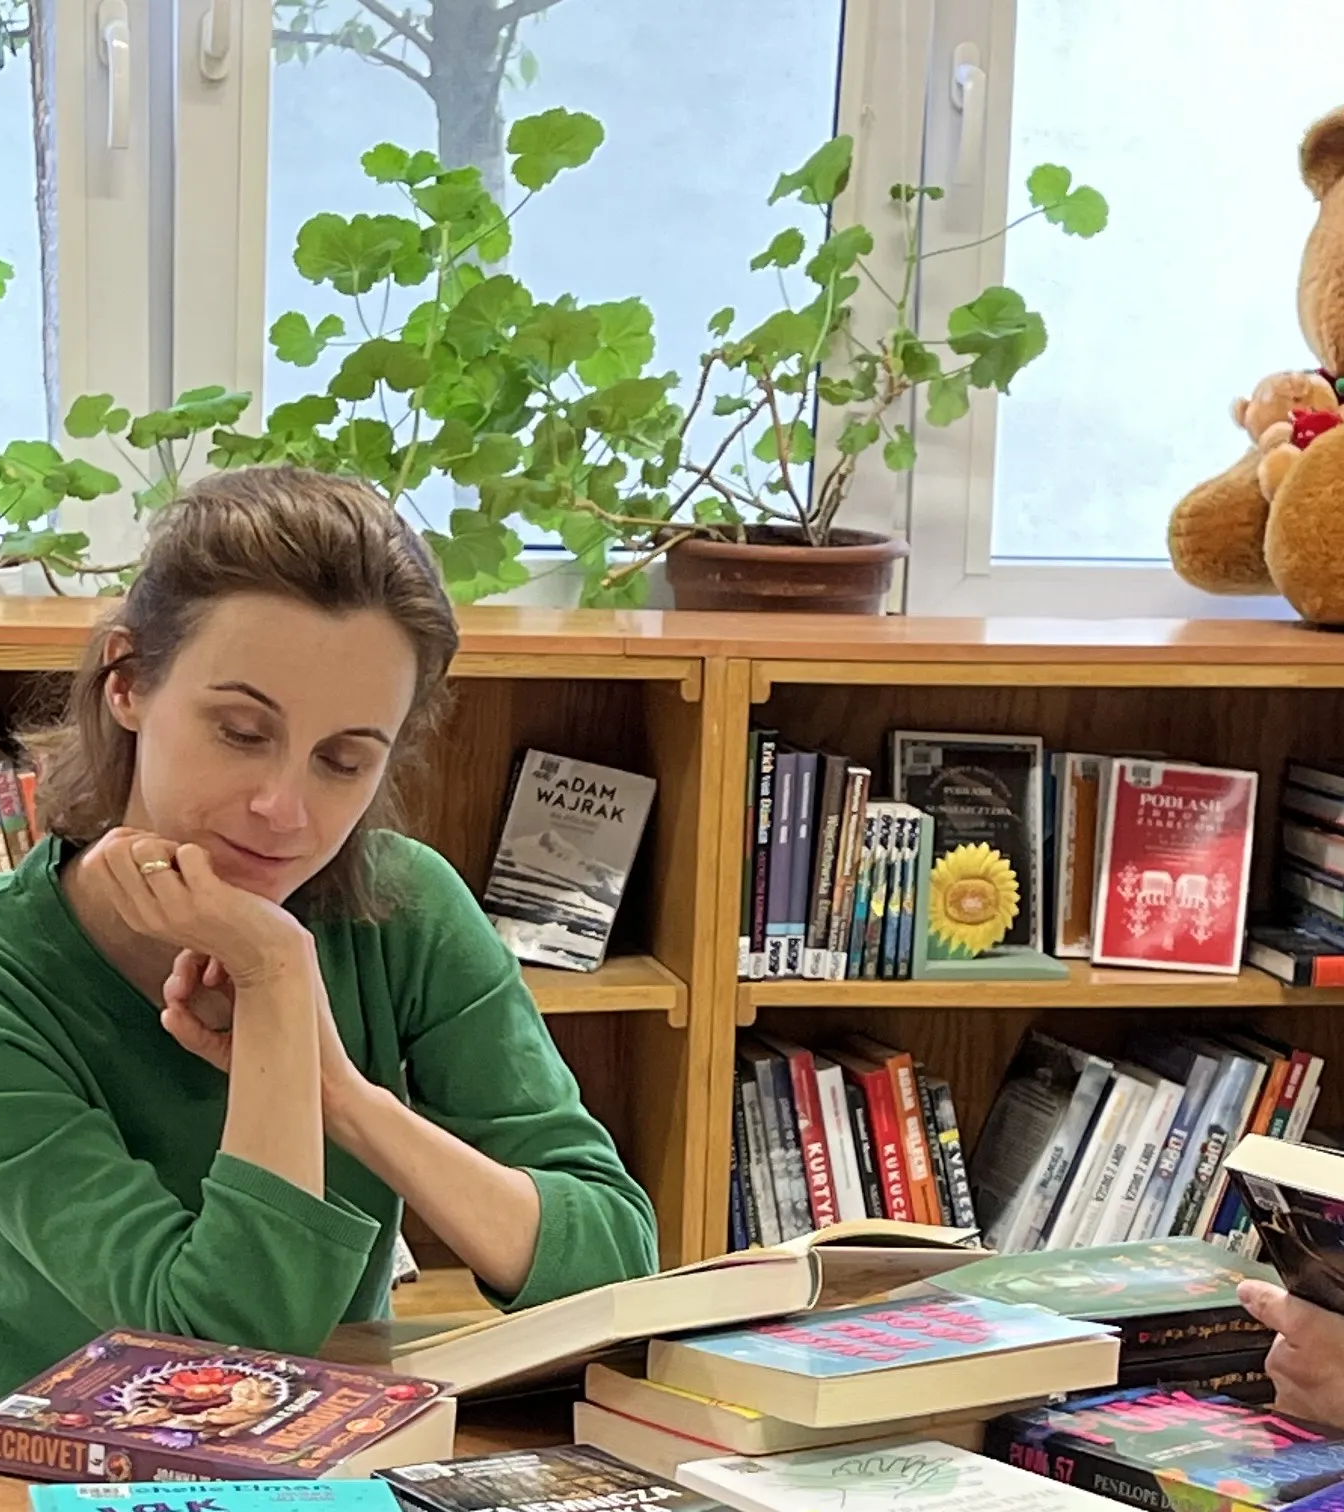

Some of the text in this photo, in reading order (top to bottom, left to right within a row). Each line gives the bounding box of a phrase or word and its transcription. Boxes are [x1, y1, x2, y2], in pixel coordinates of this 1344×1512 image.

[537, 787, 626, 823] WAJRAK
[555, 777, 617, 801] ADAM
[807, 1141, 834, 1229] KURTYK
[882, 1142, 907, 1222] KUKUCZ
[1094, 1474, 1161, 1505] PENELOPE
